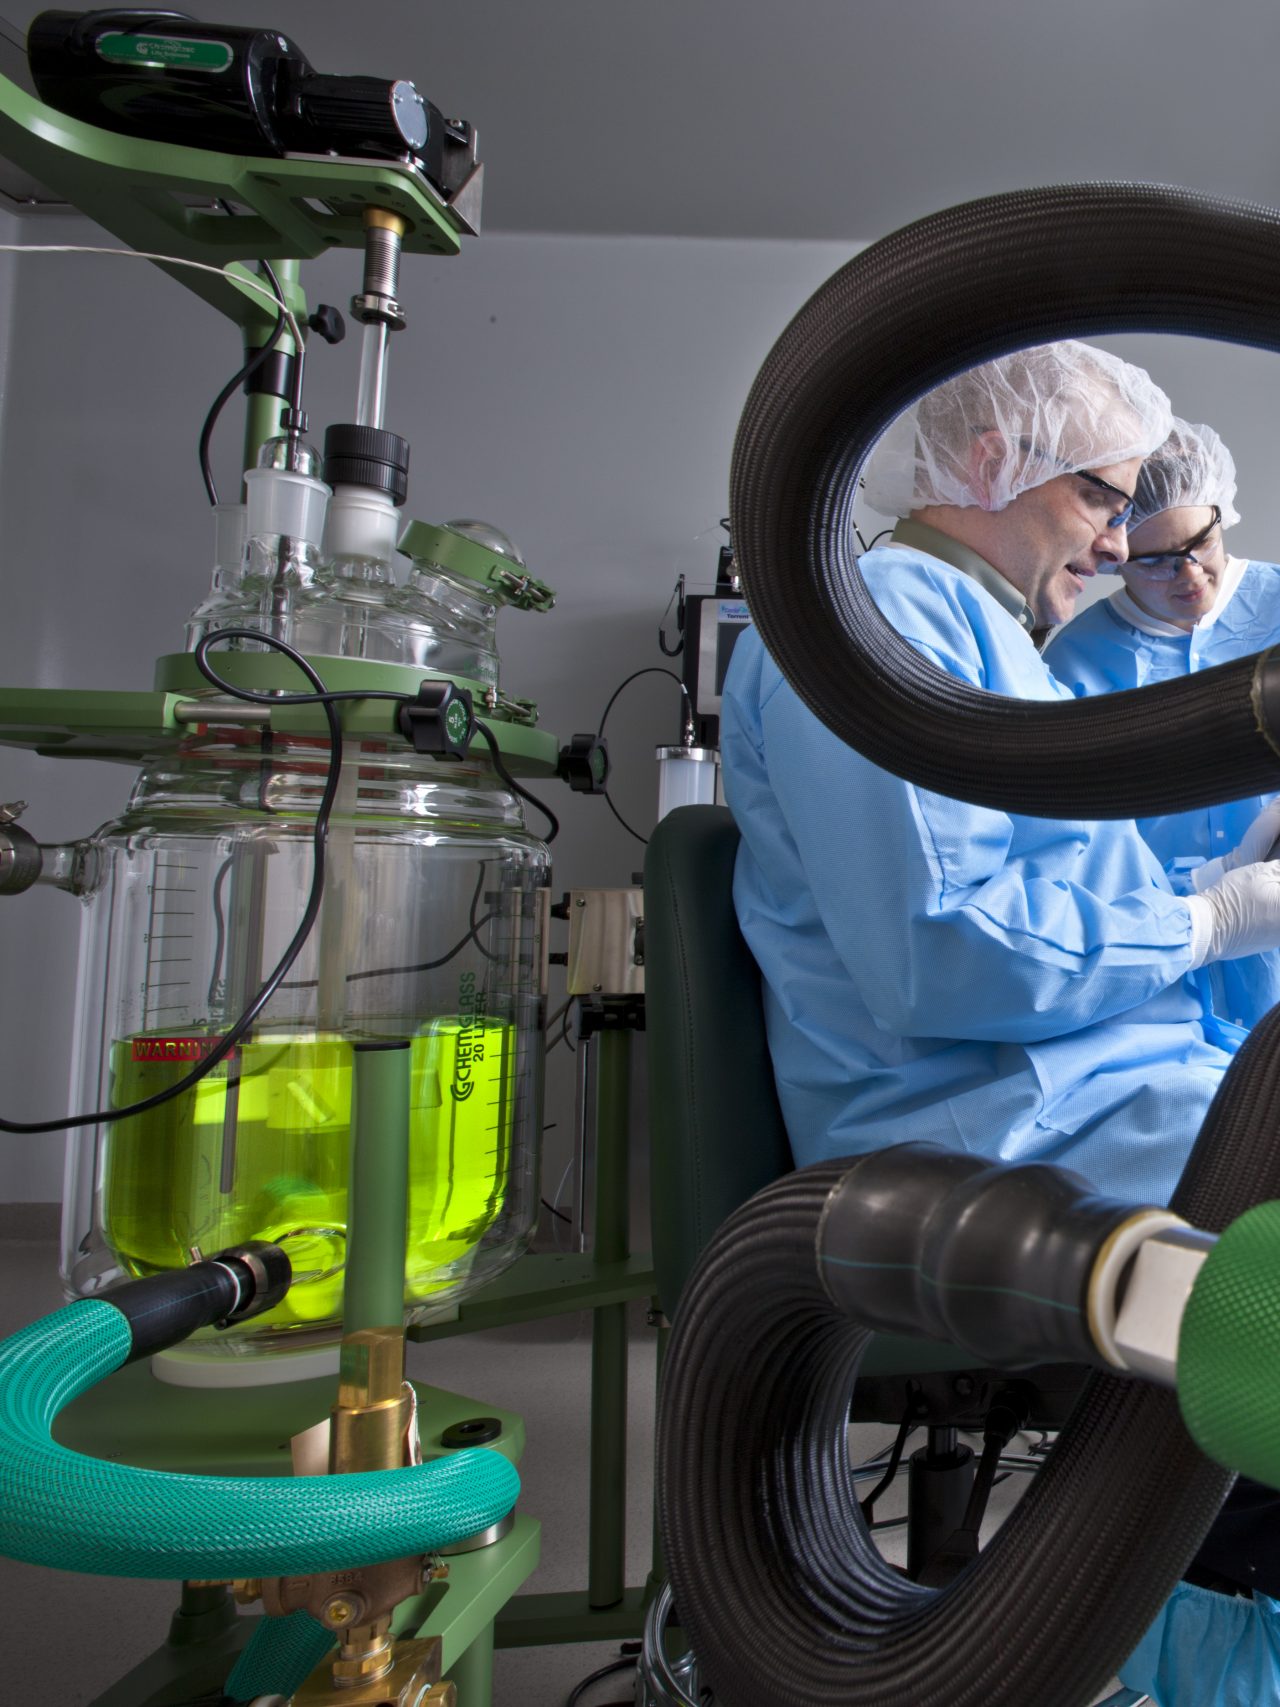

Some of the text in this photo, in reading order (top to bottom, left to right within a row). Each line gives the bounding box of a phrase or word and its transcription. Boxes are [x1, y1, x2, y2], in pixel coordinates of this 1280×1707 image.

[136, 1042, 213, 1057] WARNIN
[456, 971, 476, 1081] CHEMGLASS
[473, 991, 488, 1062] 20 LITER
